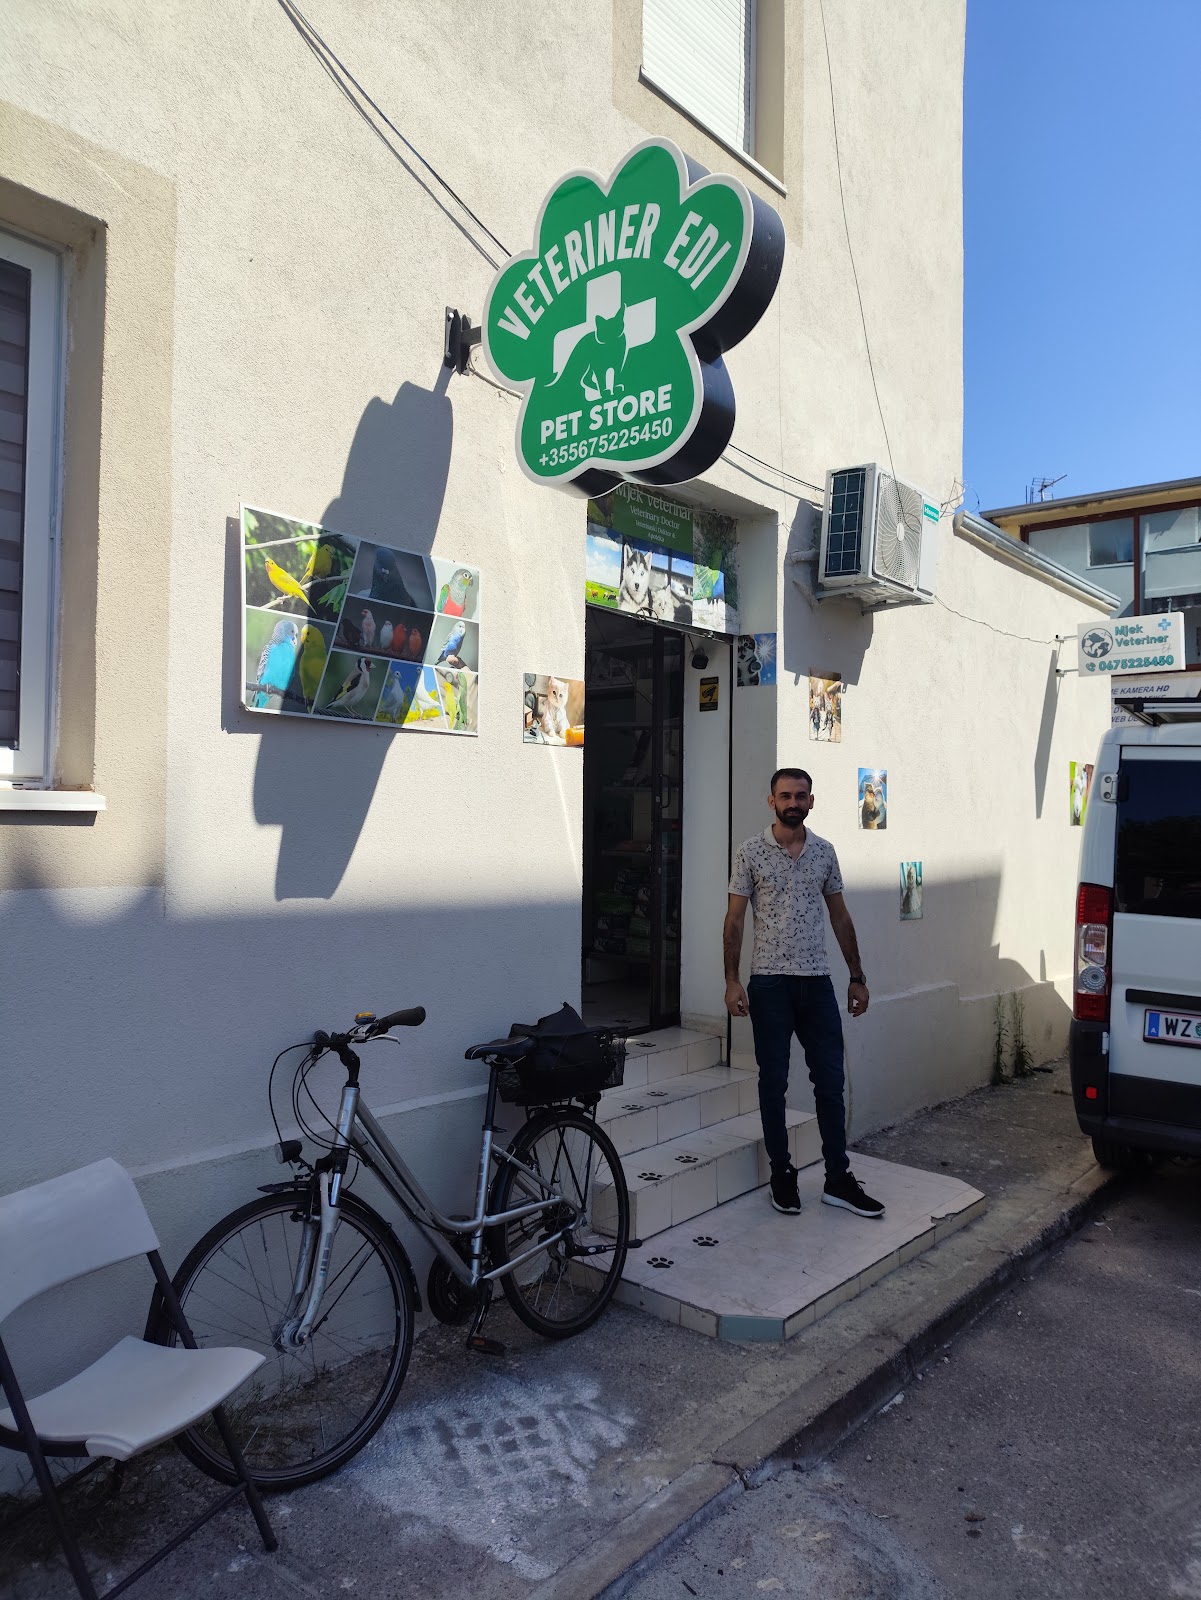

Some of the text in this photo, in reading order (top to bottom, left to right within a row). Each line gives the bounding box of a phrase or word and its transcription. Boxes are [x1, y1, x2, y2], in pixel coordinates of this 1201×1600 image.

[497, 202, 732, 341] VETERINER EDI
[540, 383, 672, 444] PET STORE
[538, 417, 673, 467] +355675225450
[630, 505, 680, 530] Veterinary Doctor
[1115, 624, 1143, 637] Mjek
[1115, 636, 1169, 648] Veteriner
[1099, 655, 1174, 671] 0675225450
[1120, 685, 1154, 695] KAMERA
[1156, 684, 1170, 692] HD
[1165, 1017, 1192, 1037] WZ
